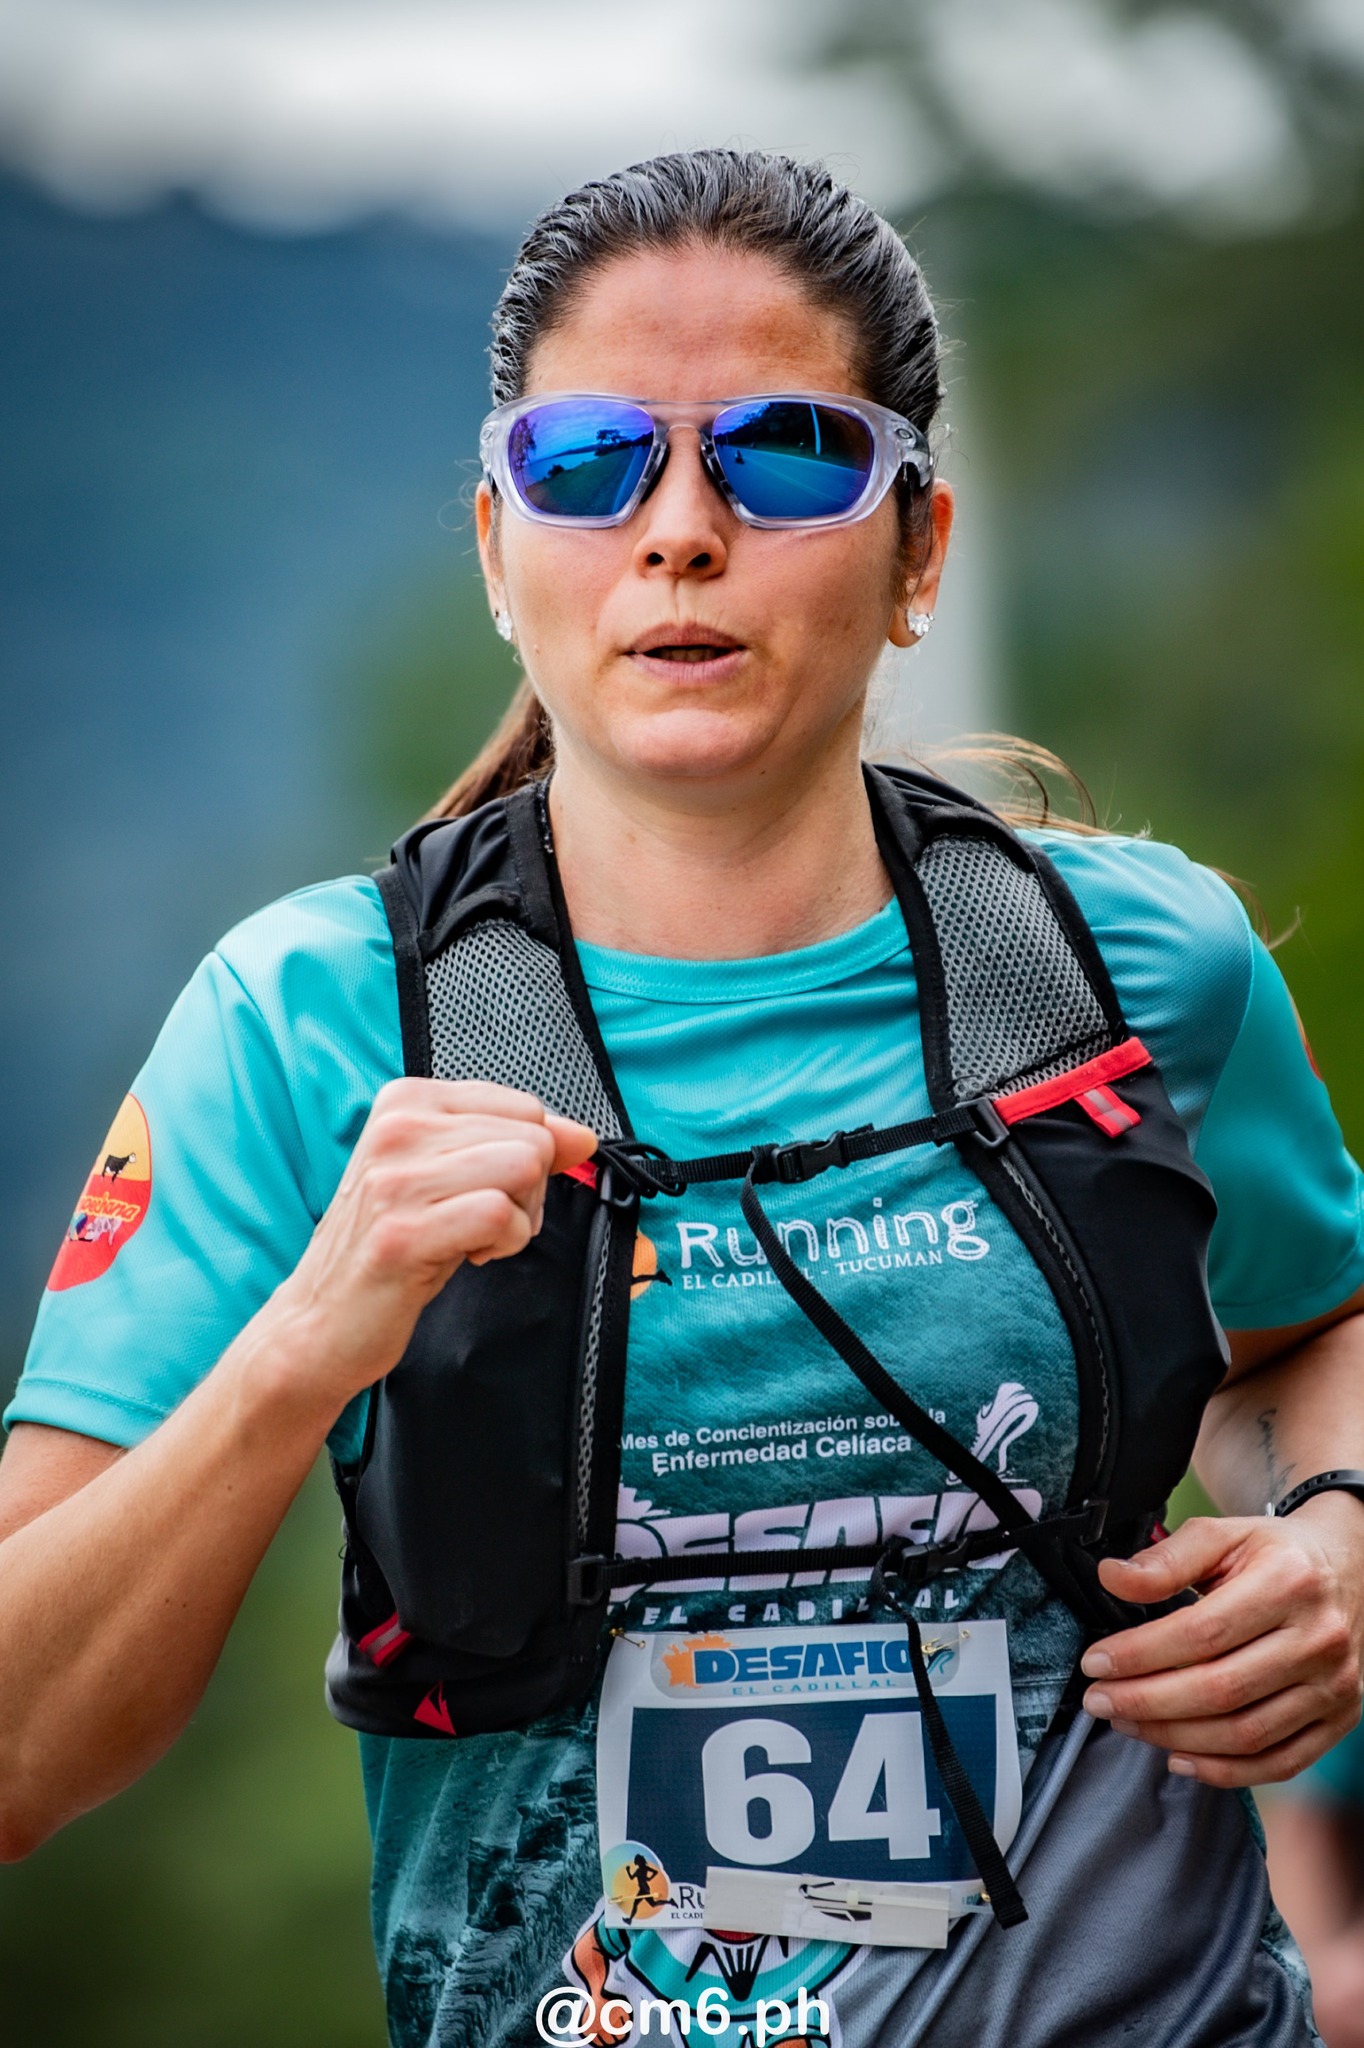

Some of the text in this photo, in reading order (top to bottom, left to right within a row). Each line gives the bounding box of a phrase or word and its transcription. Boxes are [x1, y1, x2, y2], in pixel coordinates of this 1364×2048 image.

[676, 1197, 990, 1269] Running
[682, 1274, 706, 1290] EL
[711, 1267, 814, 1290] CADILL
[835, 1250, 943, 1276] TUCUMAN
[621, 1408, 946, 1451] Mes de Concientización sob la
[652, 1432, 912, 1477] Enfermedad Celíaca
[642, 1604, 689, 1626] EL
[694, 1640, 914, 1685] DESAFIO
[732, 1679, 897, 1696] EL CADILLAL
[702, 1711, 942, 1866] 64
